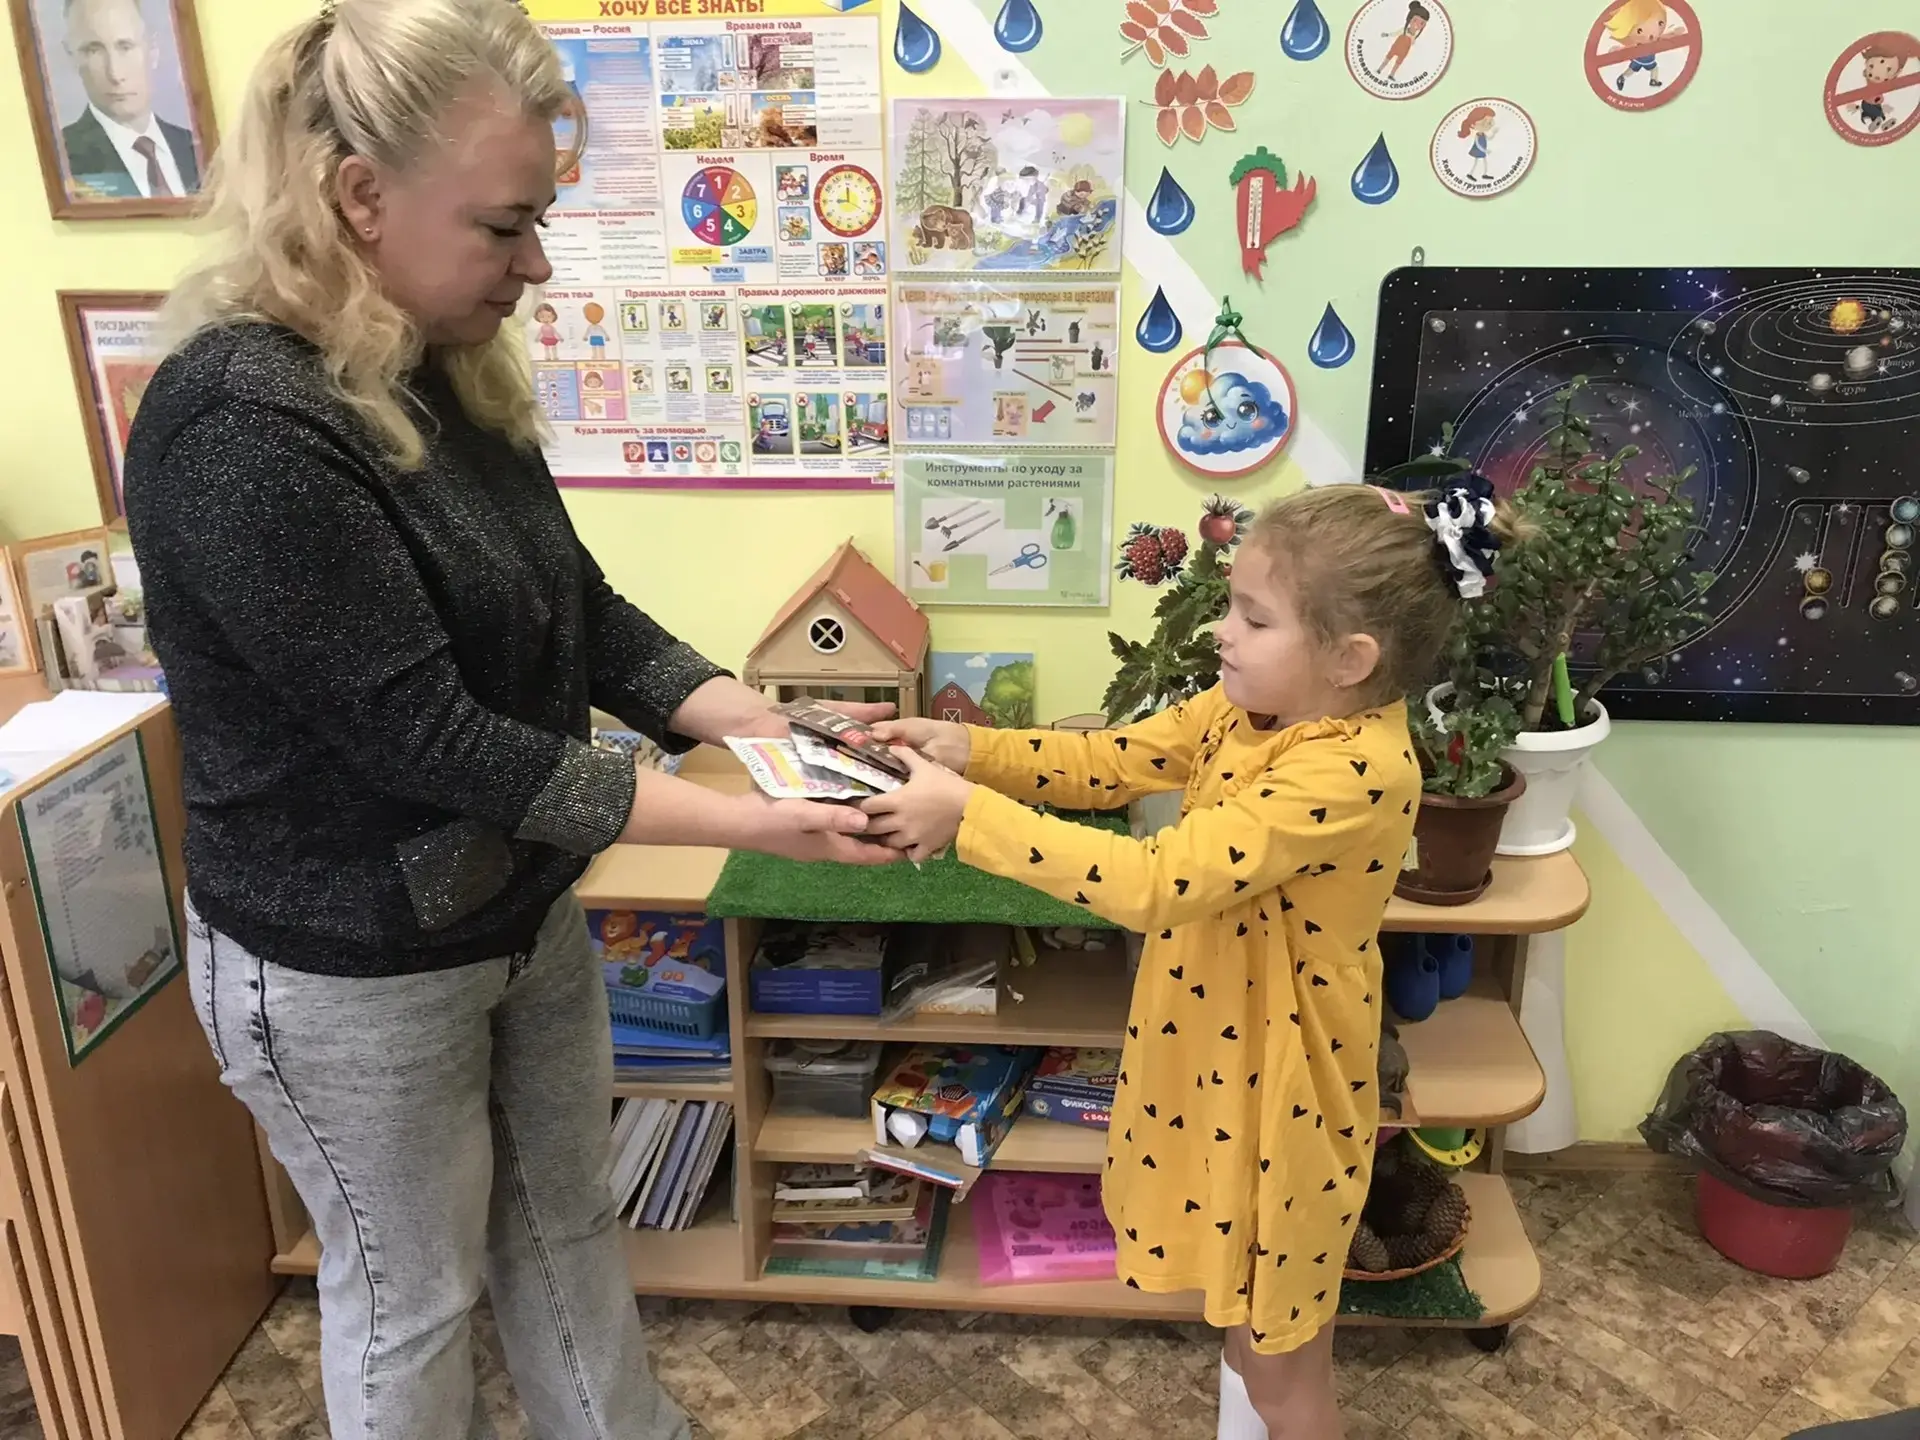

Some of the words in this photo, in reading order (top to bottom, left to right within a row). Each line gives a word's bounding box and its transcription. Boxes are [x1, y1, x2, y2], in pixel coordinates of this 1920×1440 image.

[599, 0, 649, 16] ХОЧУ
[698, 0, 764, 14] ЗНАТЬ!
[593, 24, 631, 34] Россия
[725, 21, 775, 31] Времена
[777, 21, 802, 29] года
[1356, 39, 1388, 87] Разговаривай
[1389, 71, 1428, 89] спокойно
[697, 155, 734, 164] Неделя
[810, 153, 844, 162] Время
[1442, 159, 1455, 178] Ходи
[1453, 176, 1463, 184] по
[1463, 181, 1492, 190] группе
[1493, 156, 1523, 186] спокойно
[714, 175, 722, 189] 1
[697, 184, 706, 197] 7
[731, 185, 741, 199] 2
[693, 205, 702, 218] 6
[736, 205, 745, 218] 3
[706, 219, 716, 232] 5
[723, 219, 733, 232] 4
[542, 290, 570, 299] асти
[571, 290, 593, 298] тела
[625, 289, 686, 298] Правильная
[689, 289, 726, 297] осанка
[738, 288, 779, 297] Правила
[781, 288, 835, 297] дорожного
[837, 287, 886, 296] движения
[575, 426, 598, 435] Куда
[656, 427, 707, 435] помощью
[925, 462, 1008, 475] Инструменты
[1012, 464, 1027, 473] по
[1029, 464, 1065, 475] уходу
[1069, 464, 1083, 473] за
[927, 479, 1004, 488] комнатными
[1007, 479, 1080, 489] растениями
